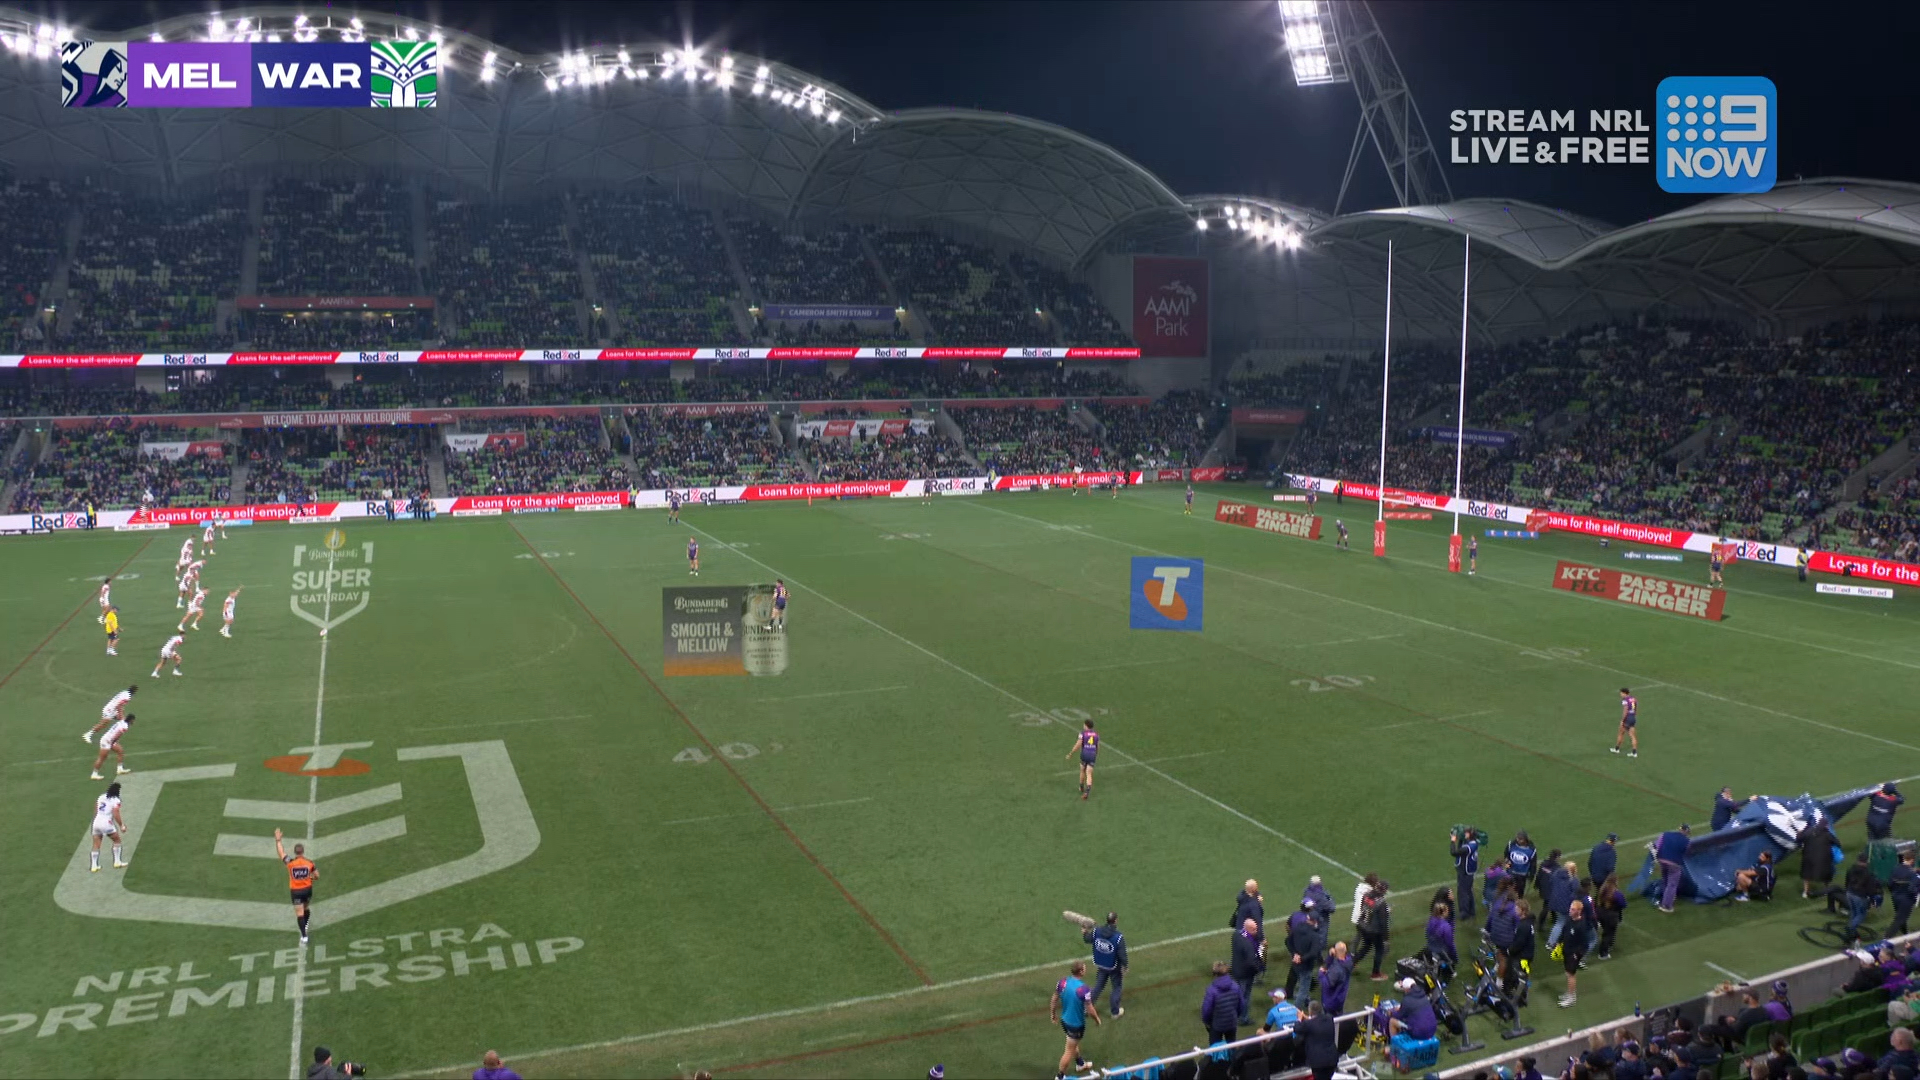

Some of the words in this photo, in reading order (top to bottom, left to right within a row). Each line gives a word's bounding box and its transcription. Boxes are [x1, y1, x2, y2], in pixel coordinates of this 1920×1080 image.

[788, 309, 825, 317] CAMERON
[826, 309, 848, 317] SMITH
[849, 309, 872, 317] STAND
[1144, 296, 1190, 316] AAMI
[1156, 316, 1188, 336] Park
[80, 356, 134, 365] self-employed
[164, 354, 207, 364] RedZed
[235, 354, 256, 362] Loans
[257, 354, 269, 362] for
[283, 354, 333, 362] self-employed
[359, 352, 399, 362] RedZed
[471, 352, 517, 360] self-employed
[543, 350, 581, 360] RedZed
[647, 350, 691, 358] self-employed
[715, 349, 750, 358] RedZed
[875, 349, 907, 358] RedZed
[263, 414, 304, 426] WELCOME
[306, 414, 317, 425] TO
[318, 413, 340, 424] AAMI
[340, 412, 362, 424] PARK
[363, 411, 412, 423] MELBOURNE
[1012, 475, 1037, 487] Loans
[1038, 474, 1052, 485] for
[1053, 474, 1068, 485] the
[1291, 474, 1321, 491] RedZed
[665, 488, 717, 503] RdZed
[758, 486, 788, 498] Loans
[789, 485, 804, 497] for
[806, 485, 822, 495] the
[824, 482, 891, 496] self-employed
[1345, 485, 1364, 497] Loans
[1365, 486, 1375, 497] for
[471, 498, 504, 509] Loans
[506, 496, 524, 508] for
[526, 495, 542, 507] the
[545, 492, 620, 507] self-employed
[151, 511, 189, 523] Loans
[190, 509, 209, 522] for
[211, 508, 231, 520] the
[233, 503, 317, 520] self-emploed
[1220, 504, 1246, 515] KFC
[1468, 501, 1508, 519] RedZed
[1257, 508, 1287, 523] PASS
[1289, 512, 1313, 527] THE
[1254, 517, 1312, 538] ZINGER
[1569, 516, 1583, 529] for
[1585, 519, 1601, 532] the
[1602, 521, 1672, 543] self-employed
[1736, 541, 1777, 563] dZed
[1561, 566, 1600, 581] KFC
[1871, 560, 1893, 577] for
[1895, 563, 1920, 581] the
[291, 567, 372, 591] SUPER
[1619, 573, 1669, 593] PASS
[1672, 582, 1713, 603] THE
[301, 591, 360, 604] SATURDAY
[674, 596, 728, 611] BUNDABERG
[1617, 585, 1708, 618] ZINGER
[671, 622, 721, 638] SMOOTH
[723, 622, 734, 638] &
[678, 638, 729, 653] MELLOW
[1087, 735, 1095, 745] 4
[99, 802, 107, 812] 2
[72, 960, 212, 998] NRL
[228, 921, 512, 973] TELSTRA
